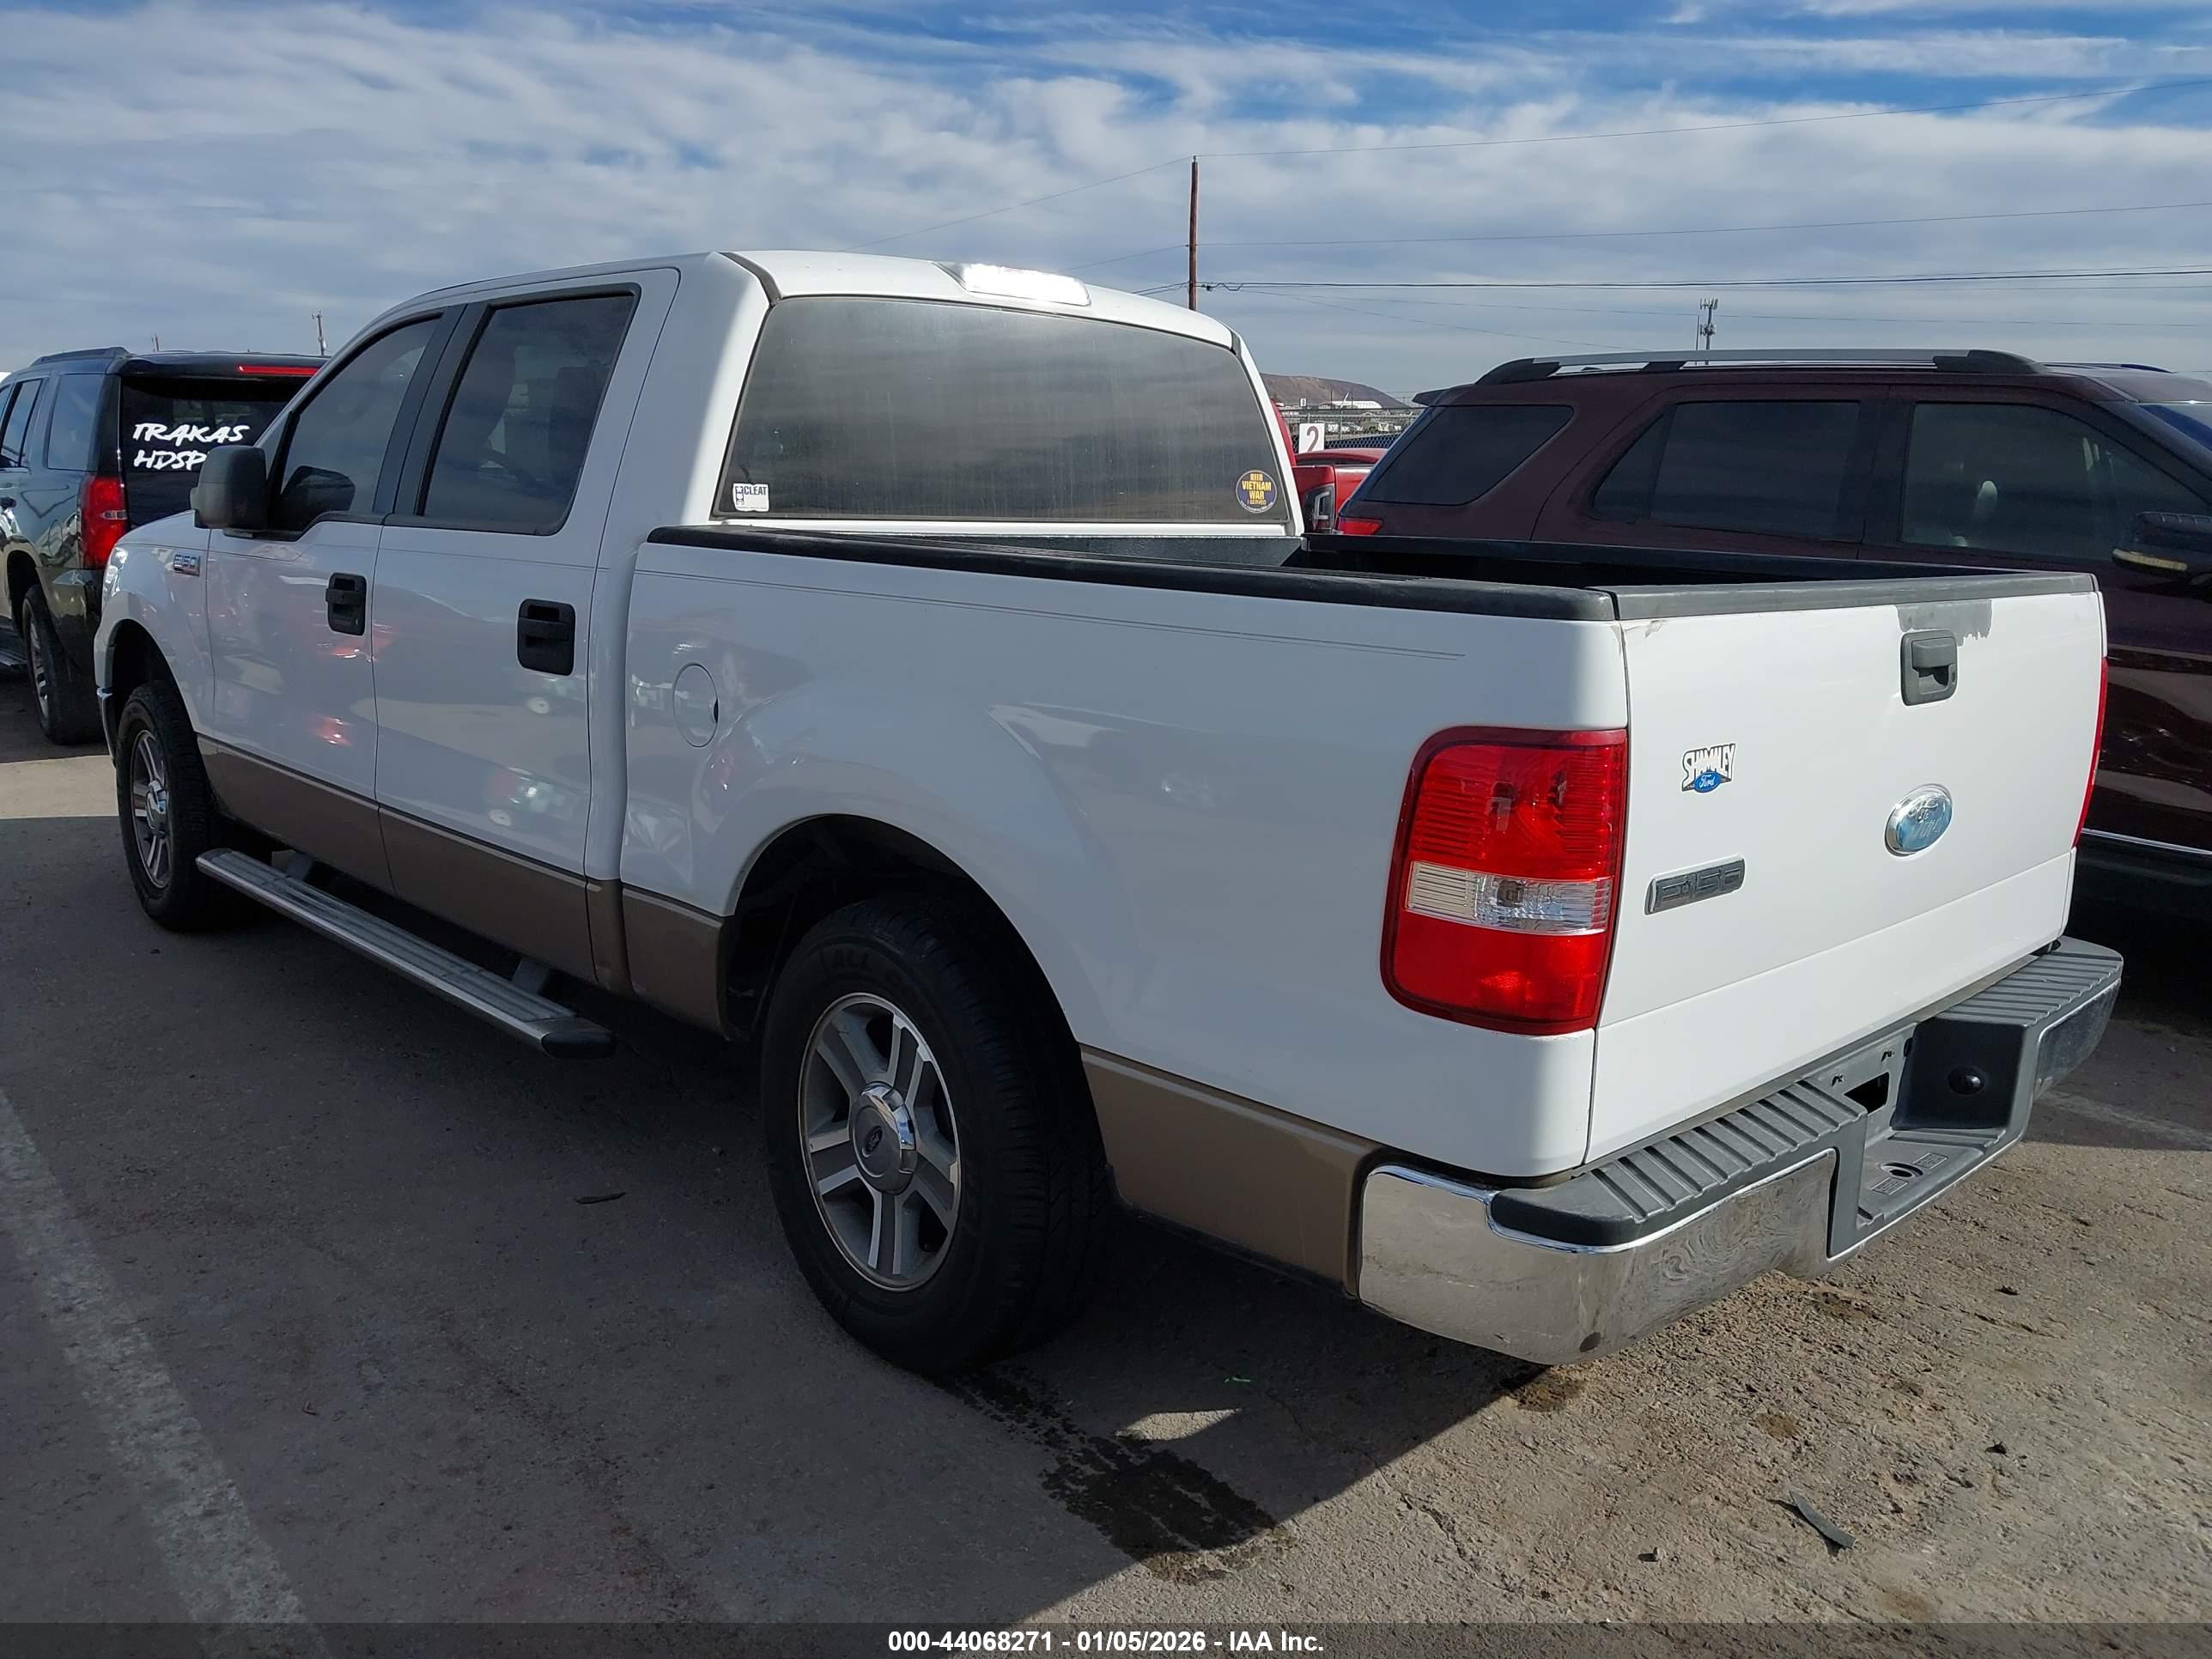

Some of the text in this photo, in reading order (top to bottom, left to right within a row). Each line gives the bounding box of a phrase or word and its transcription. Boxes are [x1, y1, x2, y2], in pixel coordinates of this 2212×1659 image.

[132, 422, 250, 447] TRAKAS
[1306, 425, 1319, 453] 2
[133, 449, 210, 471] HDSP
[744, 486, 767, 495] CLEAT
[1242, 481, 1272, 491] VIETNAM
[1249, 490, 1265, 500] WAR
